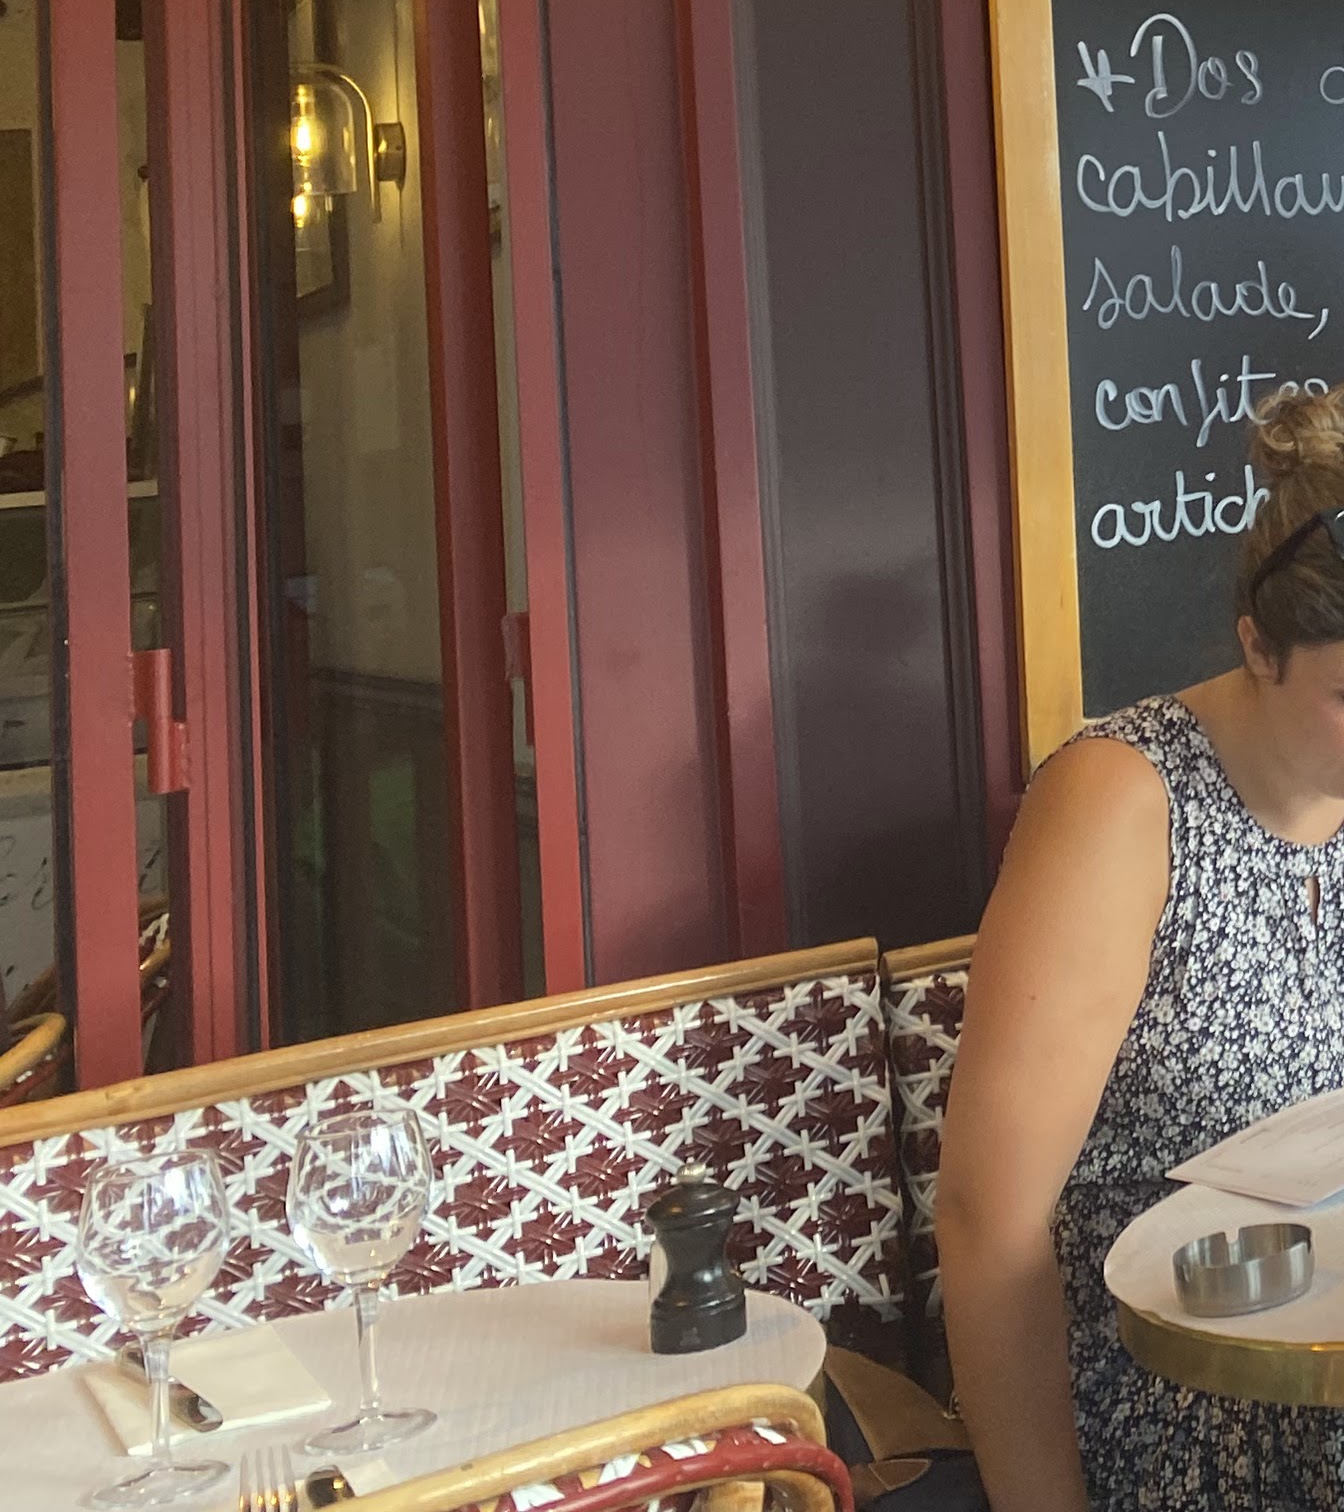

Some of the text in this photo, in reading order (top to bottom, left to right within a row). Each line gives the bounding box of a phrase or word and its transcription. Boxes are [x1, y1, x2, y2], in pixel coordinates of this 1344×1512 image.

[1129, 12, 1264, 119] Dos
[1082, 244, 1330, 340] salade,
[1090, 463, 1271, 550] artich
